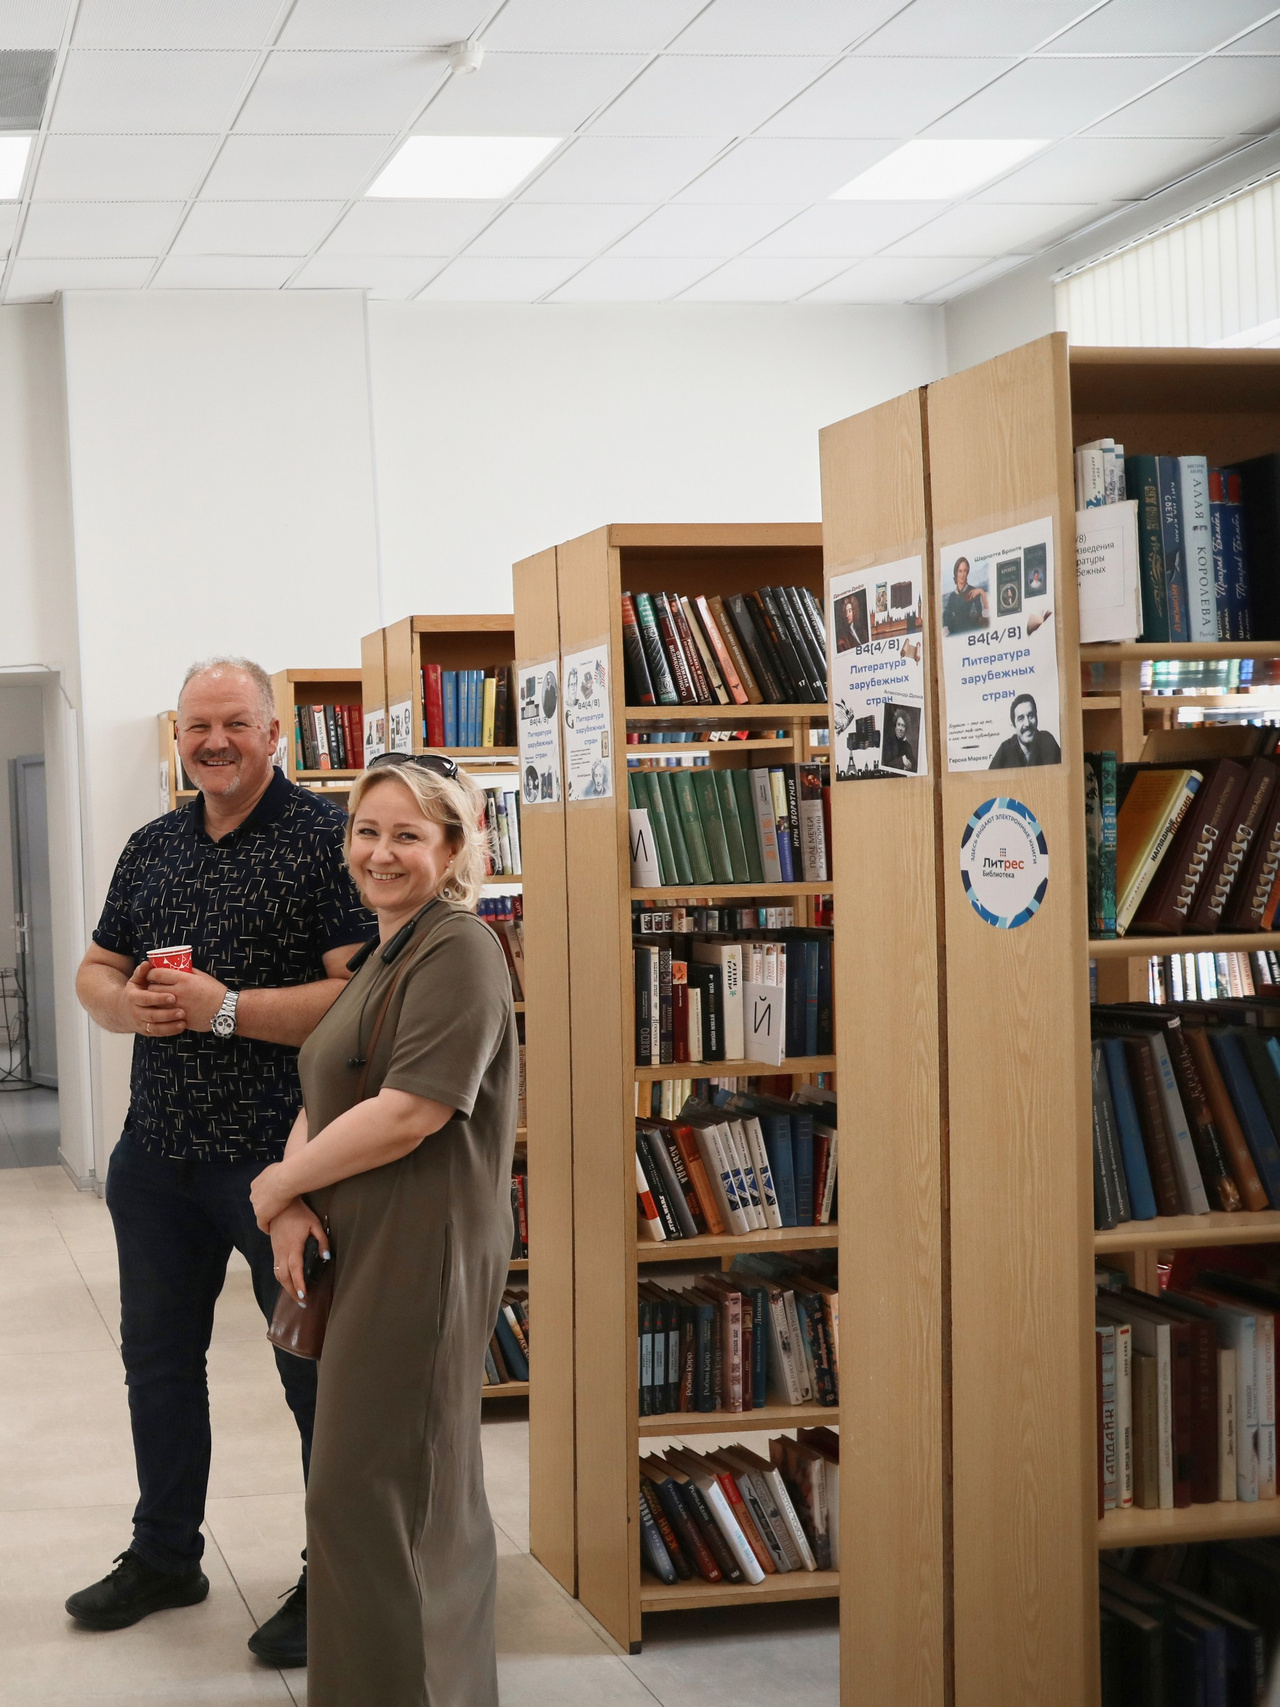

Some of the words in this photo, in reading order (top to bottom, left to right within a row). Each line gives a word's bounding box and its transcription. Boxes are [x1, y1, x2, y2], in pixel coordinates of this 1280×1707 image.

[1164, 495, 1174, 524] СВЕТА
[1193, 478, 1204, 519] АЛАЯ
[974, 551, 1001, 563] Шарлотта
[1197, 546, 1211, 627] КОРОЛЕВА
[669, 644, 687, 697] ВЕЛИКОЛЕПНОГО
[850, 659, 907, 675] Литература
[962, 648, 1031, 668] Литература
[849, 675, 910, 691] зарубежных
[961, 666, 1035, 685] зарубежных
[866, 696, 893, 706] стран
[982, 689, 1016, 702] стран
[576, 712, 604, 723] Литература
[576, 724, 606, 735] зарубежных
[528, 729, 552, 738] Литература
[528, 740, 553, 749] зарубежных
[535, 752, 548, 760] стран
[787, 779, 799, 826] ОБОРОТНЕЙ
[1170, 795, 1192, 836] ПОСОБИЯ
[807, 816, 816, 844] МЕЧЕЙ
[976, 816, 995, 838] ВЫДАЮТ
[995, 814, 1030, 839] ЭЛЕКТРОННЫЕ
[1029, 839, 1037, 864] КНИГИ
[1150, 819, 1175, 863] НАГЛЯДНЫЕ
[809, 845, 817, 869] ПОЛЕ
[983, 858, 1024, 871] Литрес
[982, 870, 1015, 878] Библиотека
[754, 995, 771, 1036] Й
[1097, 1125, 1106, 1176] фантастическая
[1106, 1121, 1117, 1171] фантастическая
[669, 1145, 689, 1184] АСЬЕНДА
[1102, 1176, 1113, 1223] Американская
[1113, 1171, 1125, 1216] Американская
[1105, 1409, 1115, 1476] АПДАЙК
[651, 1530, 660, 1548] ЛОРА
[659, 1517, 678, 1550] КЕЙН
